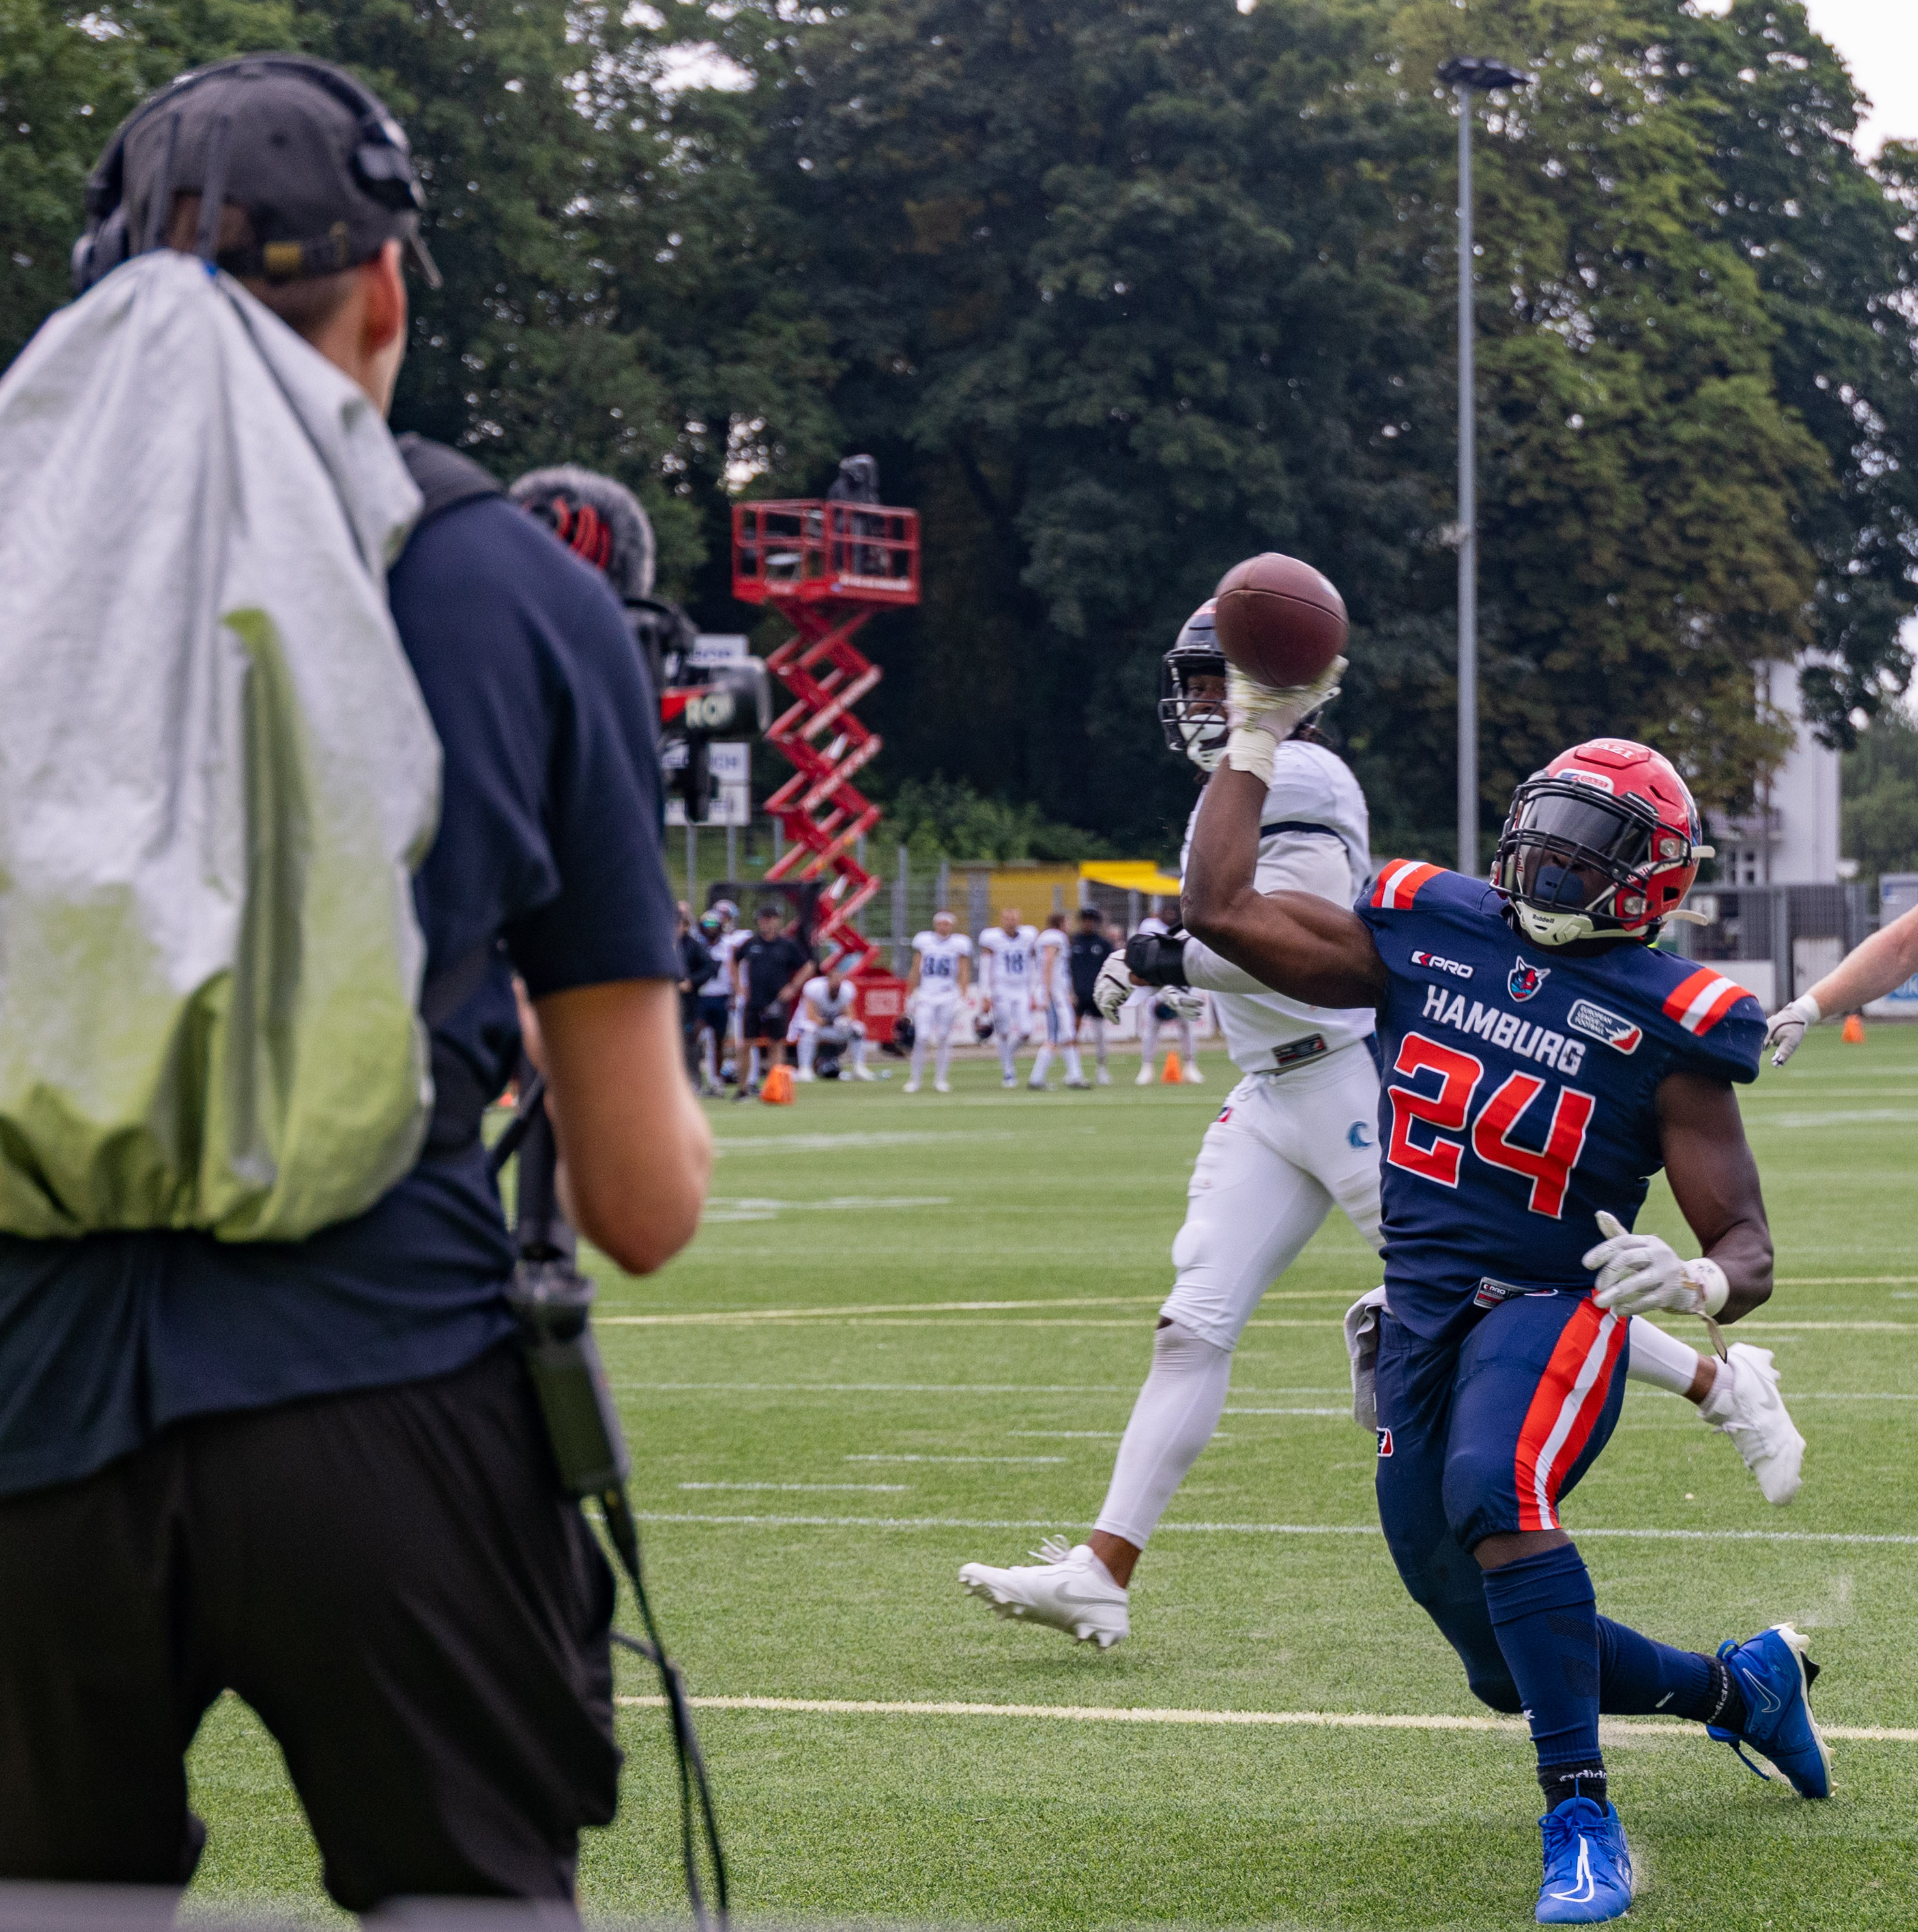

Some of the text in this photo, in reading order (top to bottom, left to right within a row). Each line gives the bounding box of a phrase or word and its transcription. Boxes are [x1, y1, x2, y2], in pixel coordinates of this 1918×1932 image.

[1532, 914, 1555, 924] Riddell
[1422, 985, 1586, 1076] HAMBURG
[1386, 1031, 1595, 1220] 24
